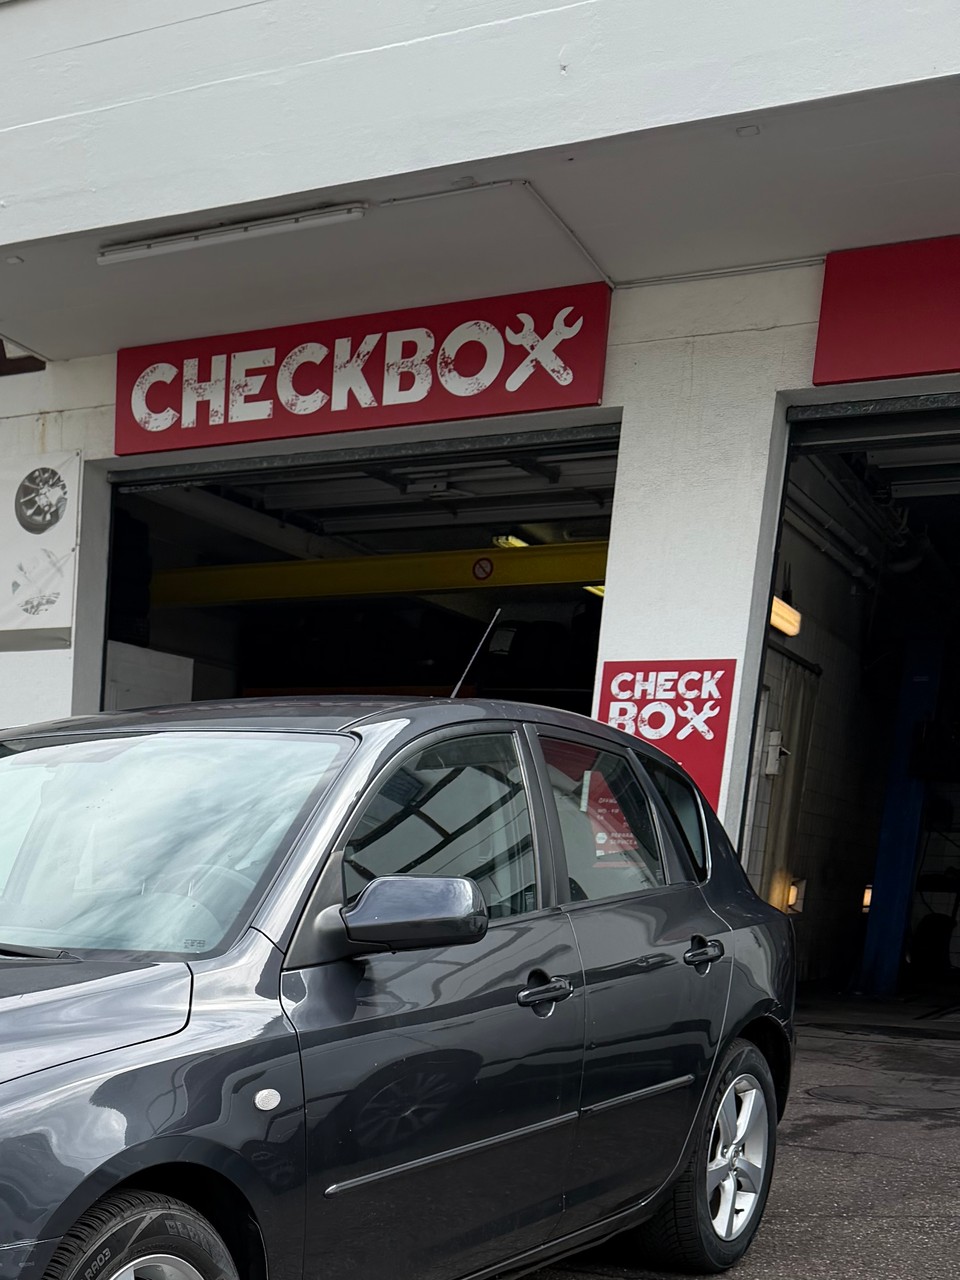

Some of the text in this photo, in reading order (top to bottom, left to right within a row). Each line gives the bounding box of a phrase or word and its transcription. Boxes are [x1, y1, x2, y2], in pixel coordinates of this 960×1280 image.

[131, 306, 584, 432] CHECKBOX
[610, 670, 725, 700] CHECK
[608, 700, 720, 740] BOX
